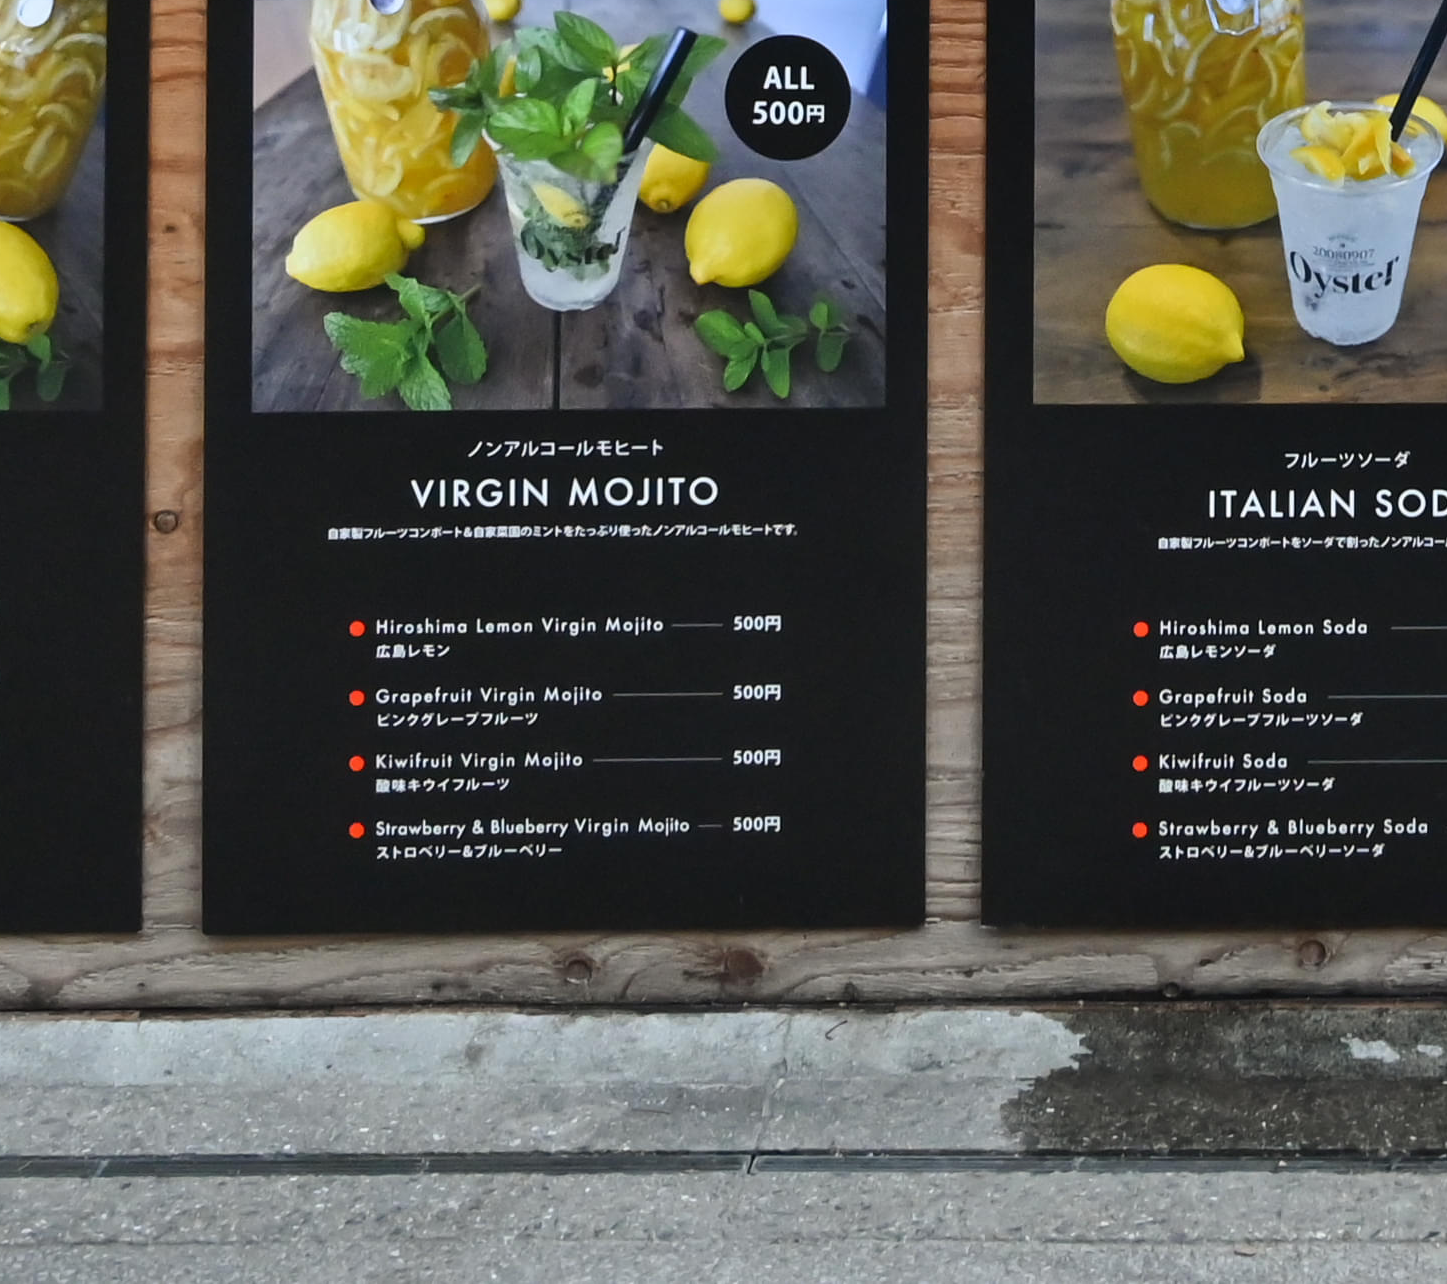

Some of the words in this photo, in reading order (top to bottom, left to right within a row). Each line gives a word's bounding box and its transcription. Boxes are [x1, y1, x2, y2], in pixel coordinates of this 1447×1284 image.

[762, 65, 815, 90] ALL
[752, 100, 825, 126] 500円
[1289, 250, 1400, 299] Oyster
[467, 438, 664, 458] ノンアルコールモヒート
[1284, 450, 1411, 469] フルーツソーダ
[410, 477, 549, 509] VIRGIN
[568, 476, 719, 507] MOJITO
[1208, 488, 1355, 519] ITALIAN
[375, 617, 468, 635] Hiroshima
[476, 617, 533, 634] Lemon
[541, 616, 597, 637] Virgin
[605, 616, 664, 636] Mojito
[733, 614, 782, 632] 500円
[1159, 618, 1250, 636] Hiroshima
[1258, 619, 1314, 636] Lemon
[1322, 617, 1368, 635] Soda
[375, 643, 451, 659] 広島レモン
[1159, 643, 1277, 660] 広島レモンソーダ
[375, 686, 473, 708] Grapefruit
[479, 686, 535, 707] Virgin
[543, 686, 603, 706] Mojito
[733, 683, 782, 702] 500円
[1158, 686, 1255, 709] Grapefruit
[1262, 686, 1307, 704] Soda
[377, 711, 539, 728] ピンクグレープフルーツ
[1160, 711, 1364, 728] ピンクグレープフルーツソーダ
[375, 751, 453, 769] Kiwifruit
[460, 752, 516, 772] Virgin
[524, 751, 583, 771] Mojito
[732, 748, 782, 767] 500円
[1158, 752, 1235, 770] Kiwifruit
[1242, 751, 1288, 769] Soda
[375, 777, 510, 794] 酸味キウイフルーツ
[1158, 776, 1336, 794] 酸味キウイフルーツソーダ
[375, 818, 466, 840] Strawberry
[471, 819, 484, 835] &
[490, 817, 569, 838] Blueberry
[574, 817, 629, 838] Virgin
[637, 817, 690, 837] Mojito
[732, 815, 781, 833] 500円
[1158, 818, 1259, 840] Strawberry
[1267, 819, 1280, 836] &
[1288, 817, 1375, 839] Blueberry
[1383, 817, 1428, 835] Soda
[376, 843, 563, 860] ストロベリー&ブルーベリー
[1159, 842, 1386, 860] ストロベリー&ブルーベリーソーダ
